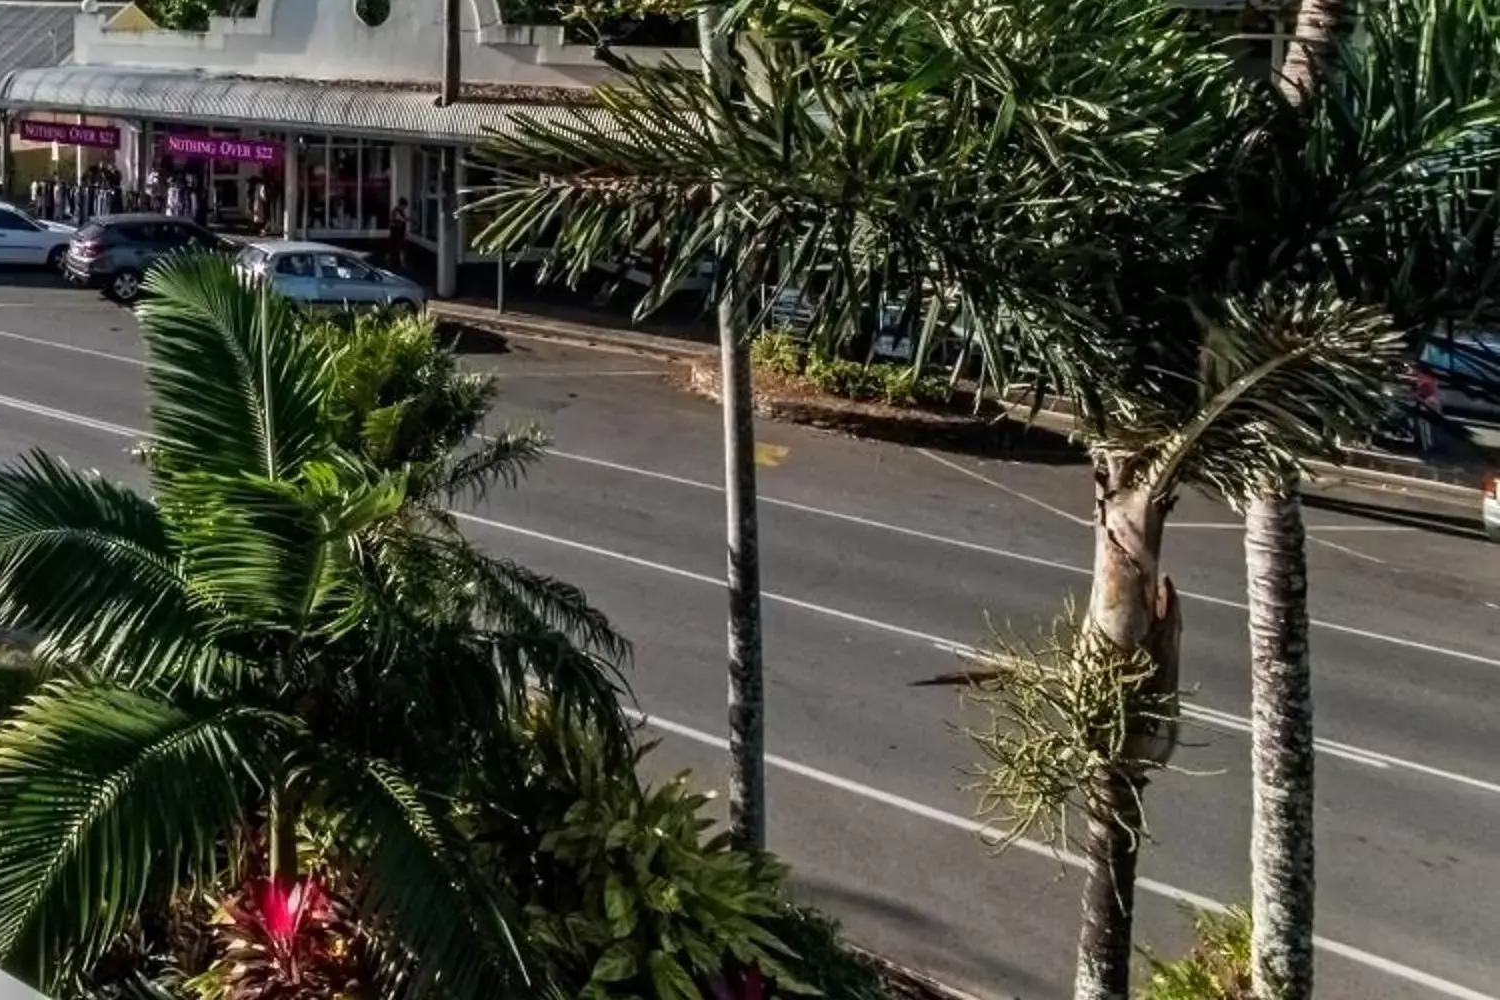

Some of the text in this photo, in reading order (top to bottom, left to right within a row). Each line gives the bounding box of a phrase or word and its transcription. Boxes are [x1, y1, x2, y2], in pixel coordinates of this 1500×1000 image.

[169, 136, 273, 159] NOTHING OVER $22
